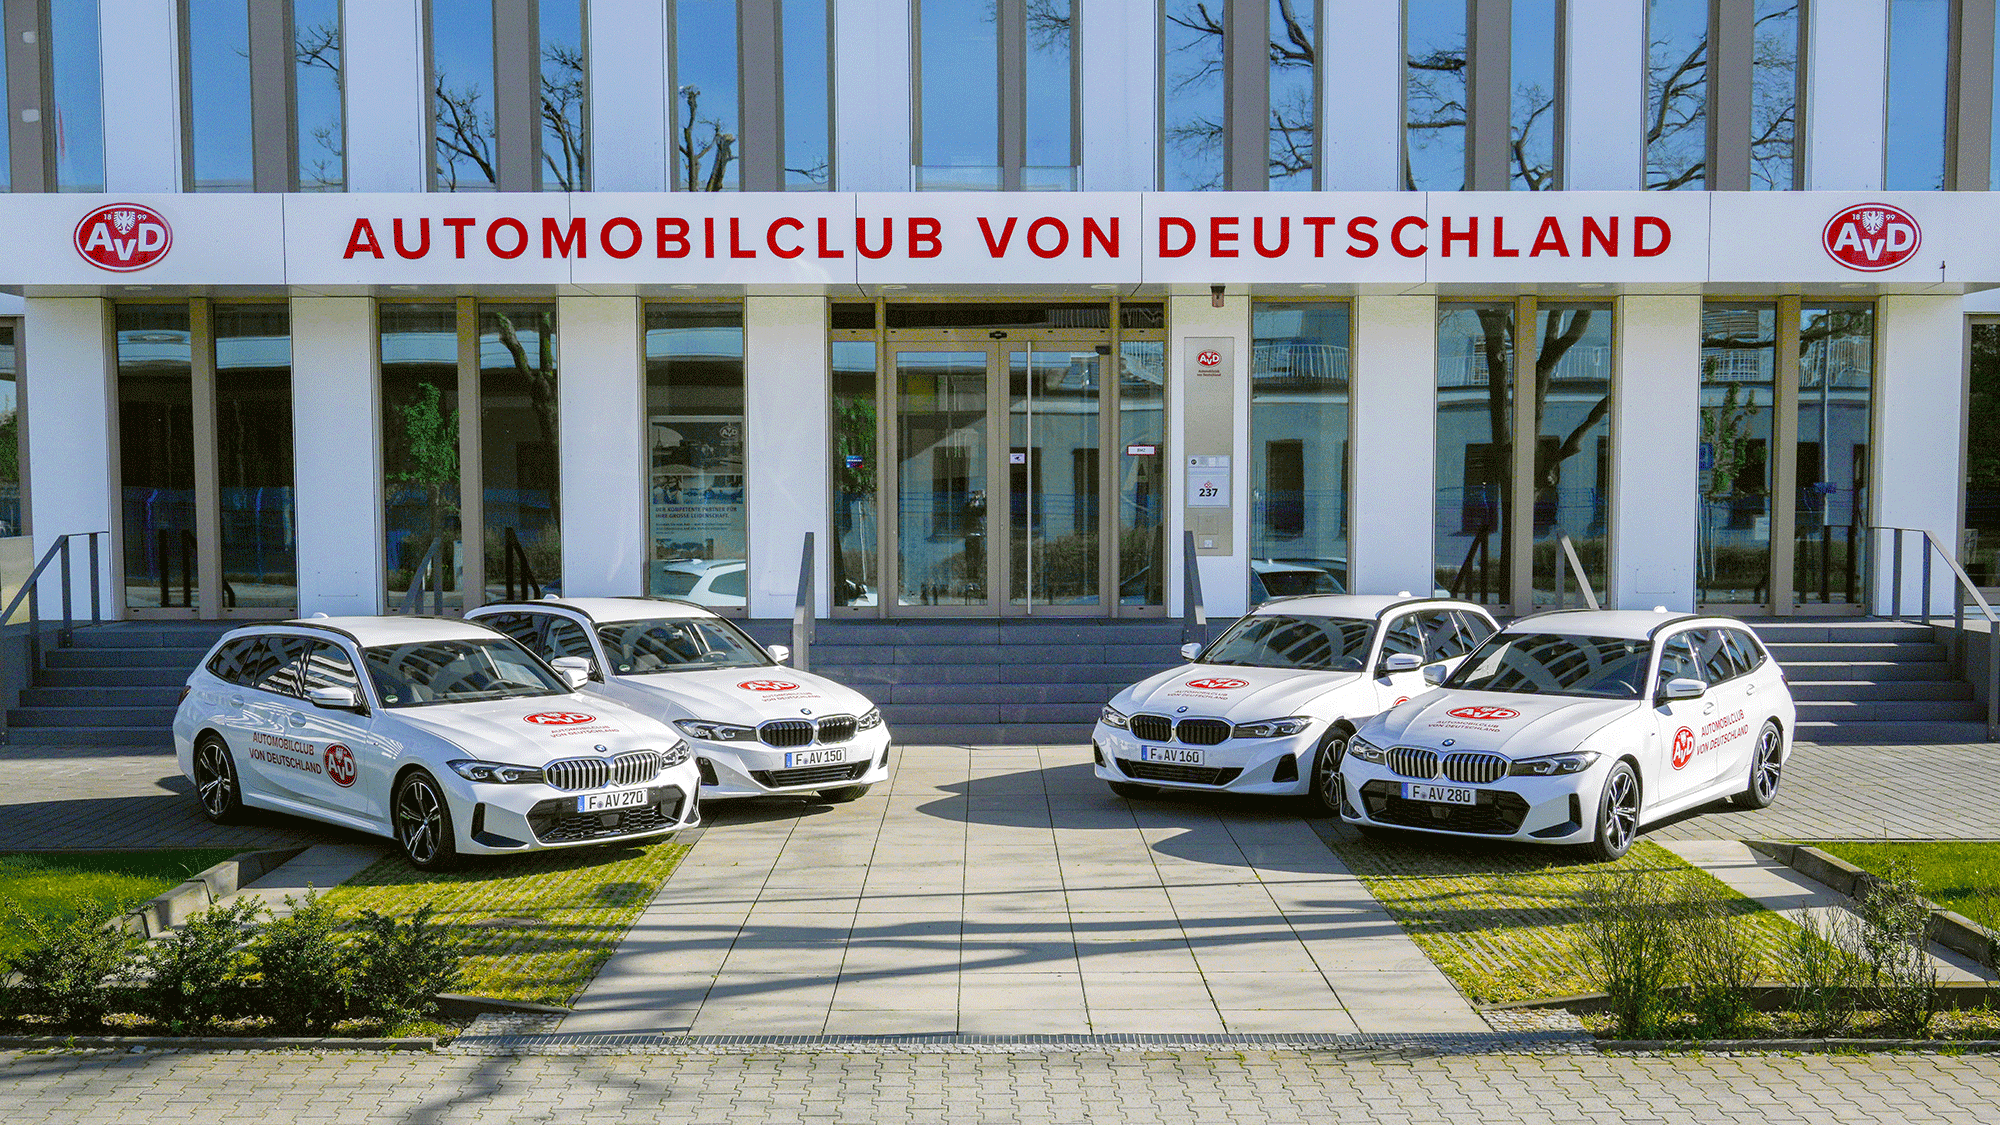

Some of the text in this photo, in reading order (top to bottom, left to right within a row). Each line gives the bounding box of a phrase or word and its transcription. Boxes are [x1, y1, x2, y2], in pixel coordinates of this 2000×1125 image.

[104, 213, 147, 221] 18 99
[343, 215, 1671, 259] AUTOMOBILCLUB VON DEUTSCHLAND
[1198, 488, 1219, 497] 237
[1701, 709, 1745, 737] AUTOMOBILCLUB
[252, 731, 315, 756] AUTOMOBILCLUB
[1696, 724, 1749, 756] VON DEUTSCHLAND
[248, 747, 322, 775] VON DEUTSCHLAND
[795, 753, 803, 765] F
[824, 749, 842, 763] 150
[1150, 748, 1158, 760] F
[1179, 750, 1200, 763] 160
[589, 795, 597, 810] F
[622, 790, 643, 806] 270
[1412, 785, 1421, 798] F
[1446, 788, 1471, 803] 280
